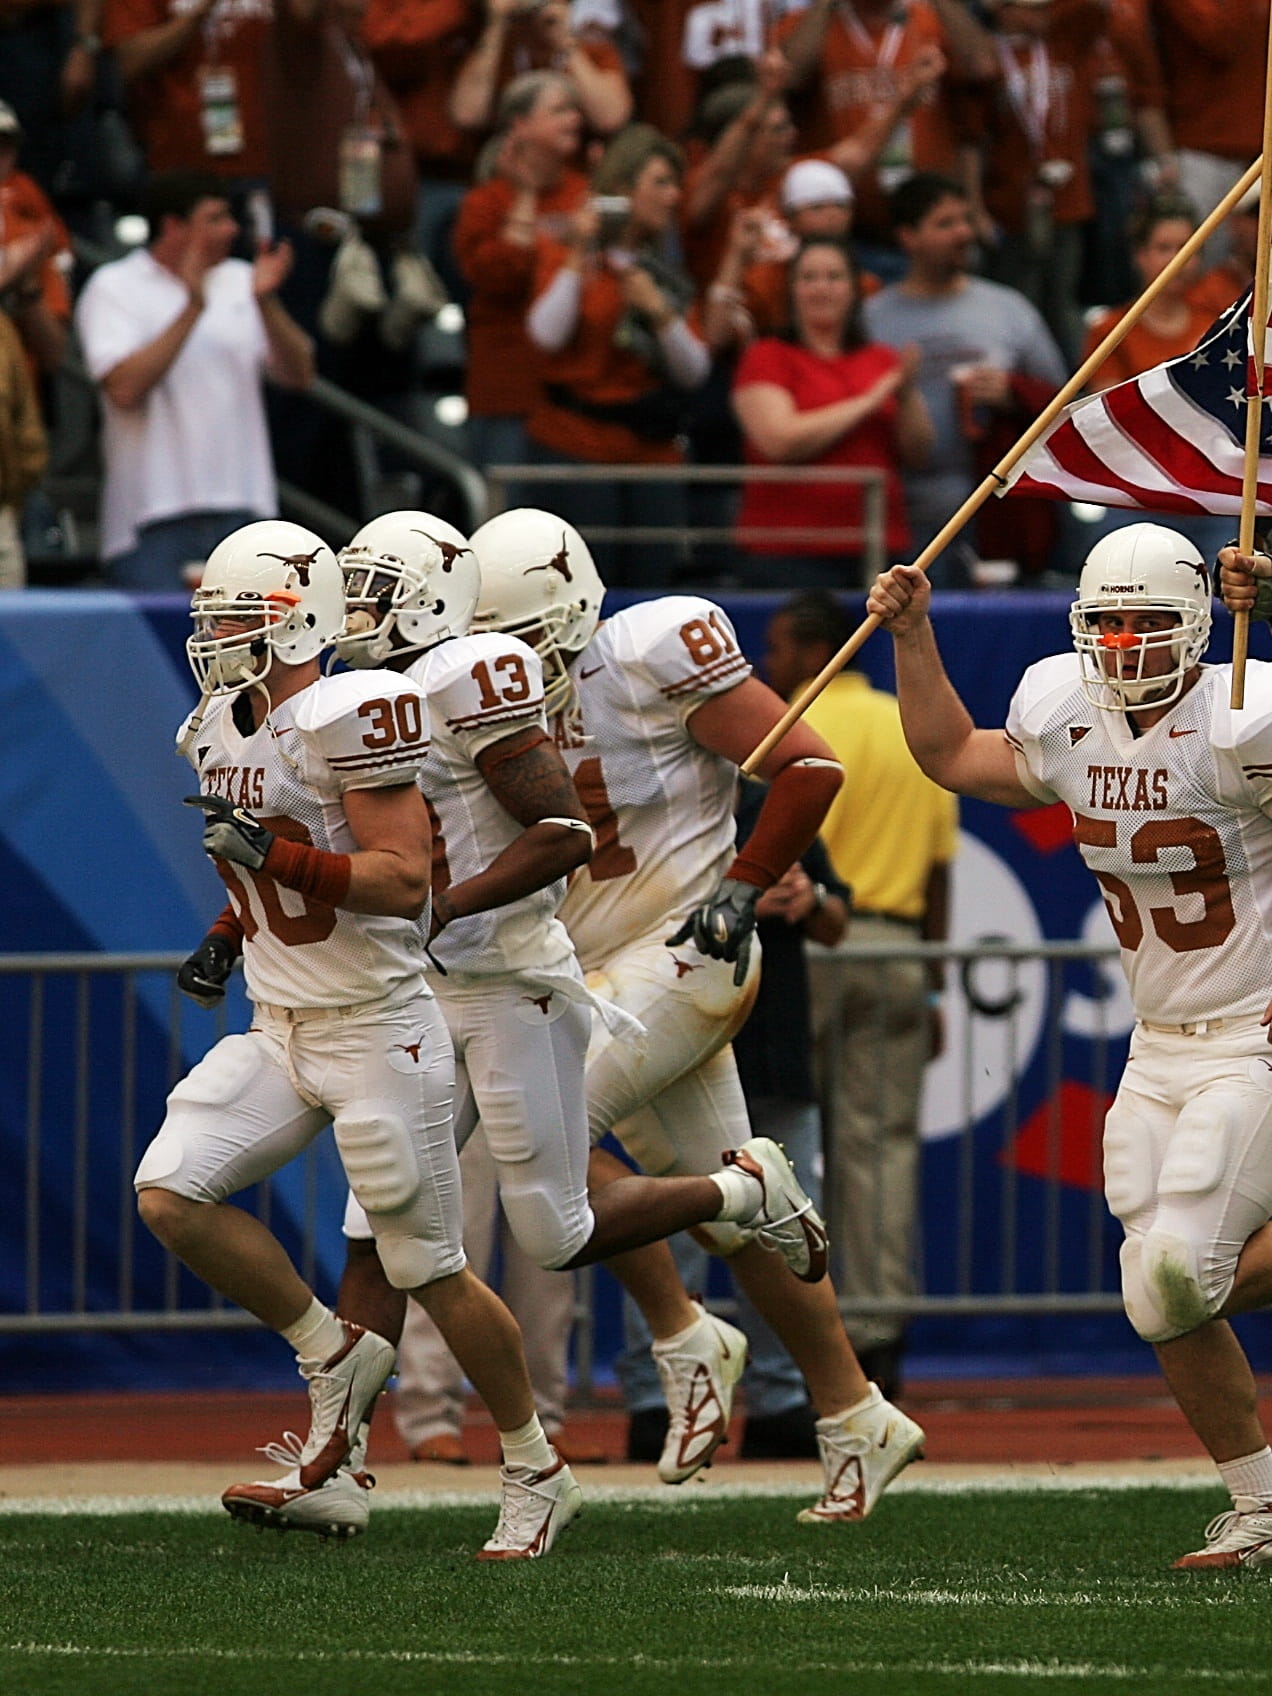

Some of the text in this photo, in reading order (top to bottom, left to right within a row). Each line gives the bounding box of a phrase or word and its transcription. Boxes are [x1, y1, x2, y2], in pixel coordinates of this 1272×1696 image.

[1111, 585, 1134, 593] HORNS
[680, 611, 737, 665] 81
[471, 653, 530, 707] 13
[357, 693, 422, 749] 30
[1088, 765, 1169, 811] TEXAS
[1074, 816, 1236, 953] 53
